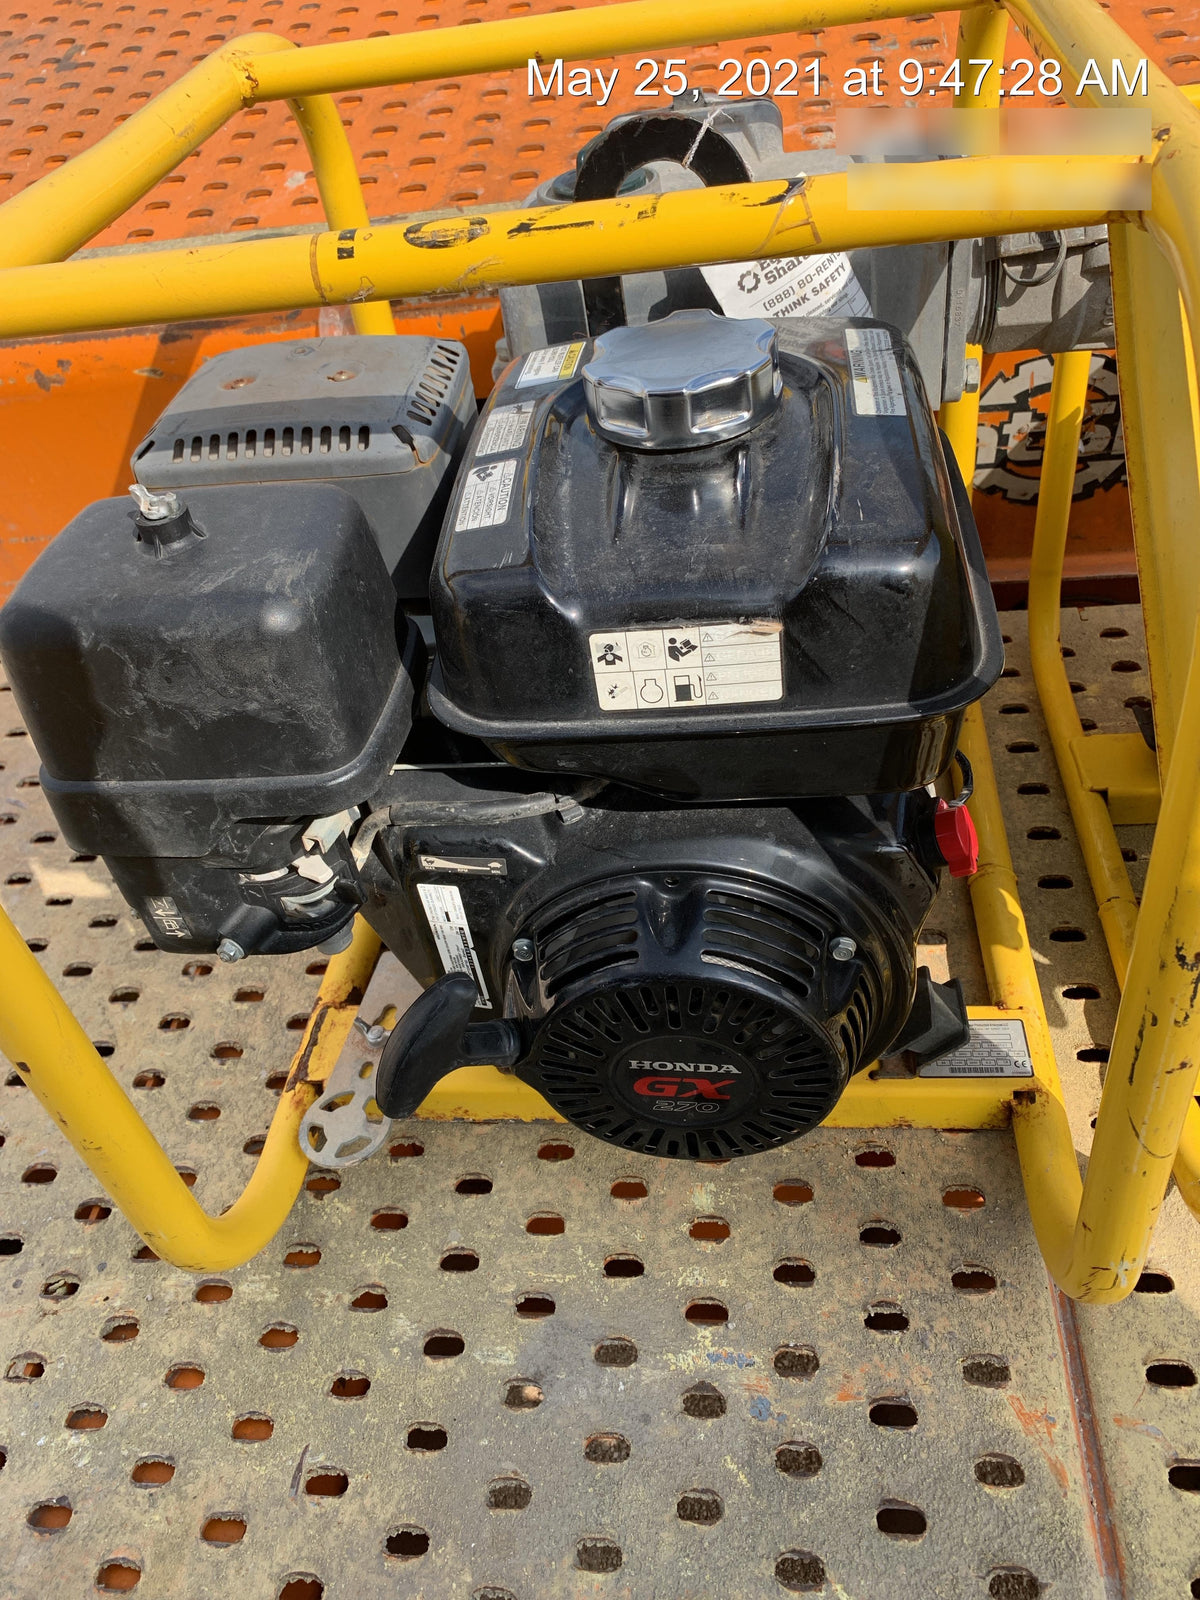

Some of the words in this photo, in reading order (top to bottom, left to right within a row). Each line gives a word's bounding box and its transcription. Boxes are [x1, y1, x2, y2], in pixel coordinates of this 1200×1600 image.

[763, 287, 796, 312] (888)
[773, 293, 810, 317] THINK
[811, 263, 847, 297] SAFETY
[850, 350, 867, 378] WARNING
[497, 476, 512, 511] CAUTION
[628, 1060, 742, 1074] HONDA
[633, 1076, 736, 1100] GX
[652, 1100, 720, 1113] 270
